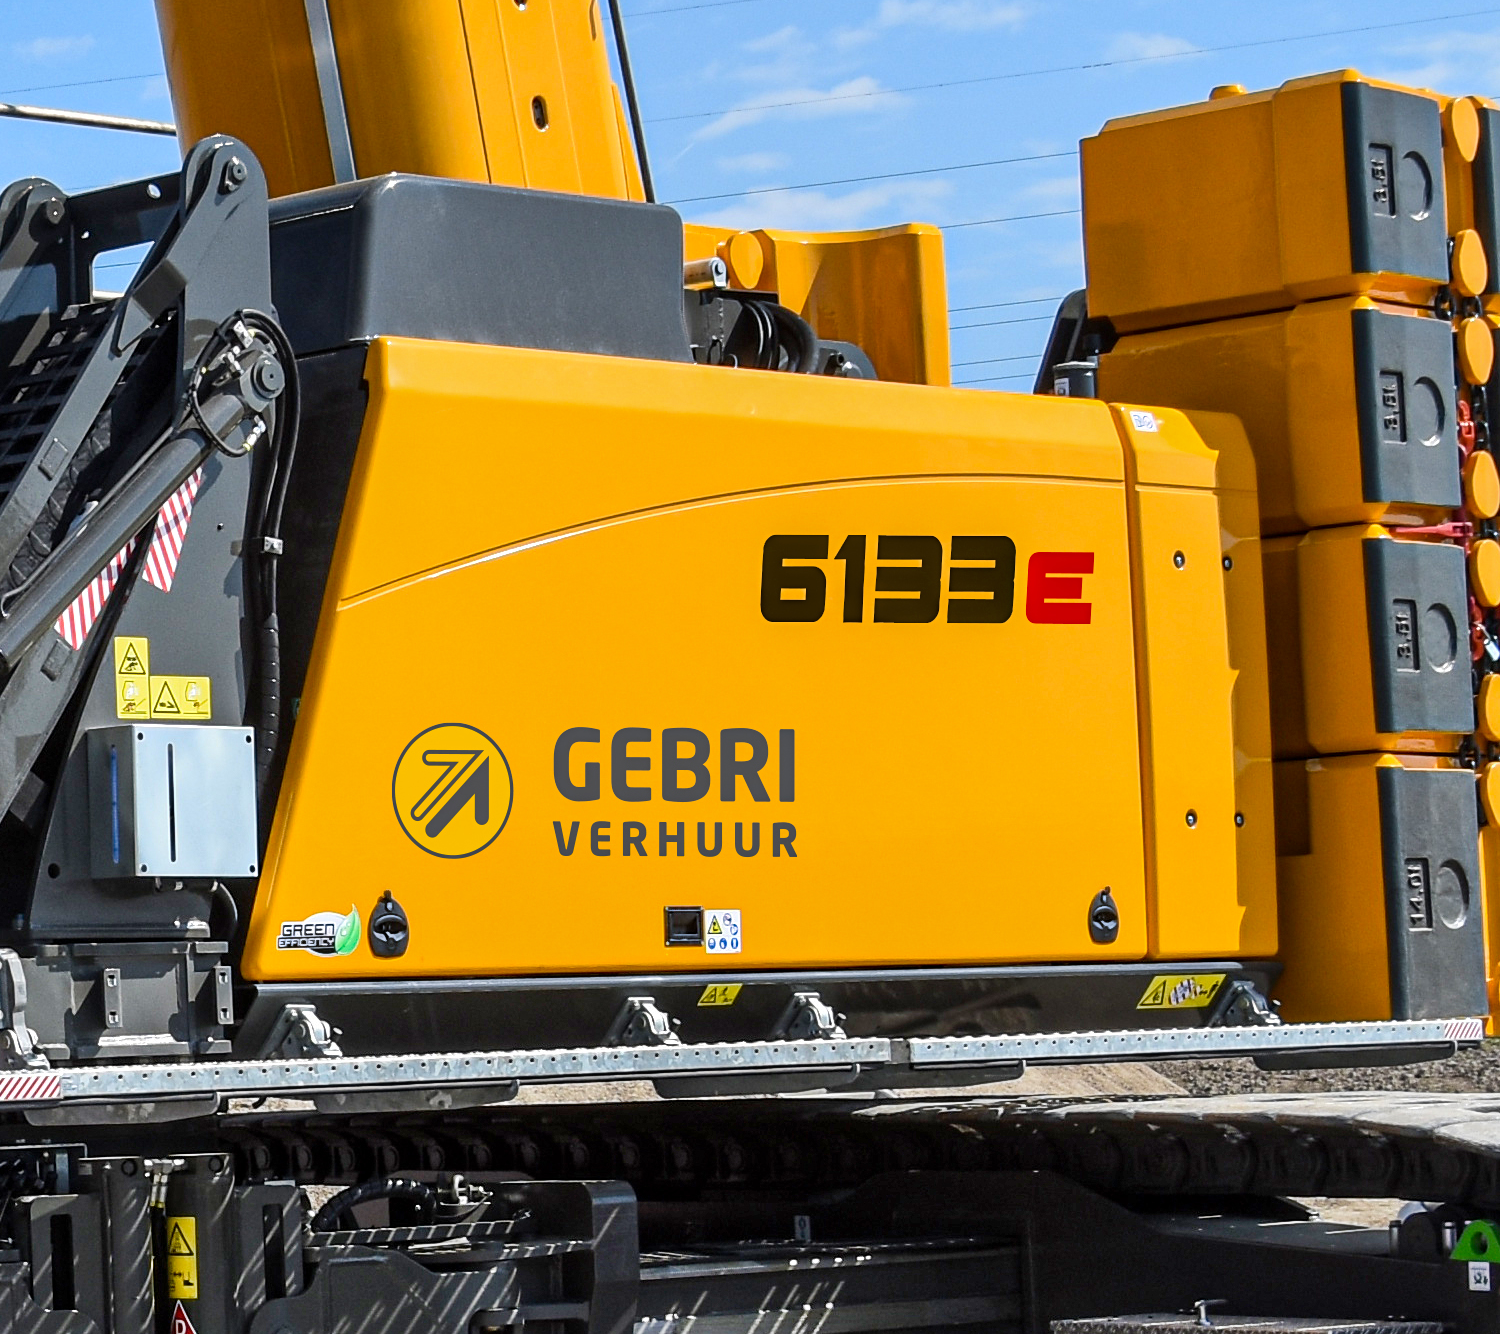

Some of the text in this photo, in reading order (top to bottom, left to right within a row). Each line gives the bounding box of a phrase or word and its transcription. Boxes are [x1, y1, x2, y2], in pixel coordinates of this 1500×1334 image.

[553, 727, 795, 802] GEBRI
[553, 821, 798, 857] VERHUUR
[279, 938, 335, 947] EFFICIENCY
[283, 923, 335, 937] GREEN
